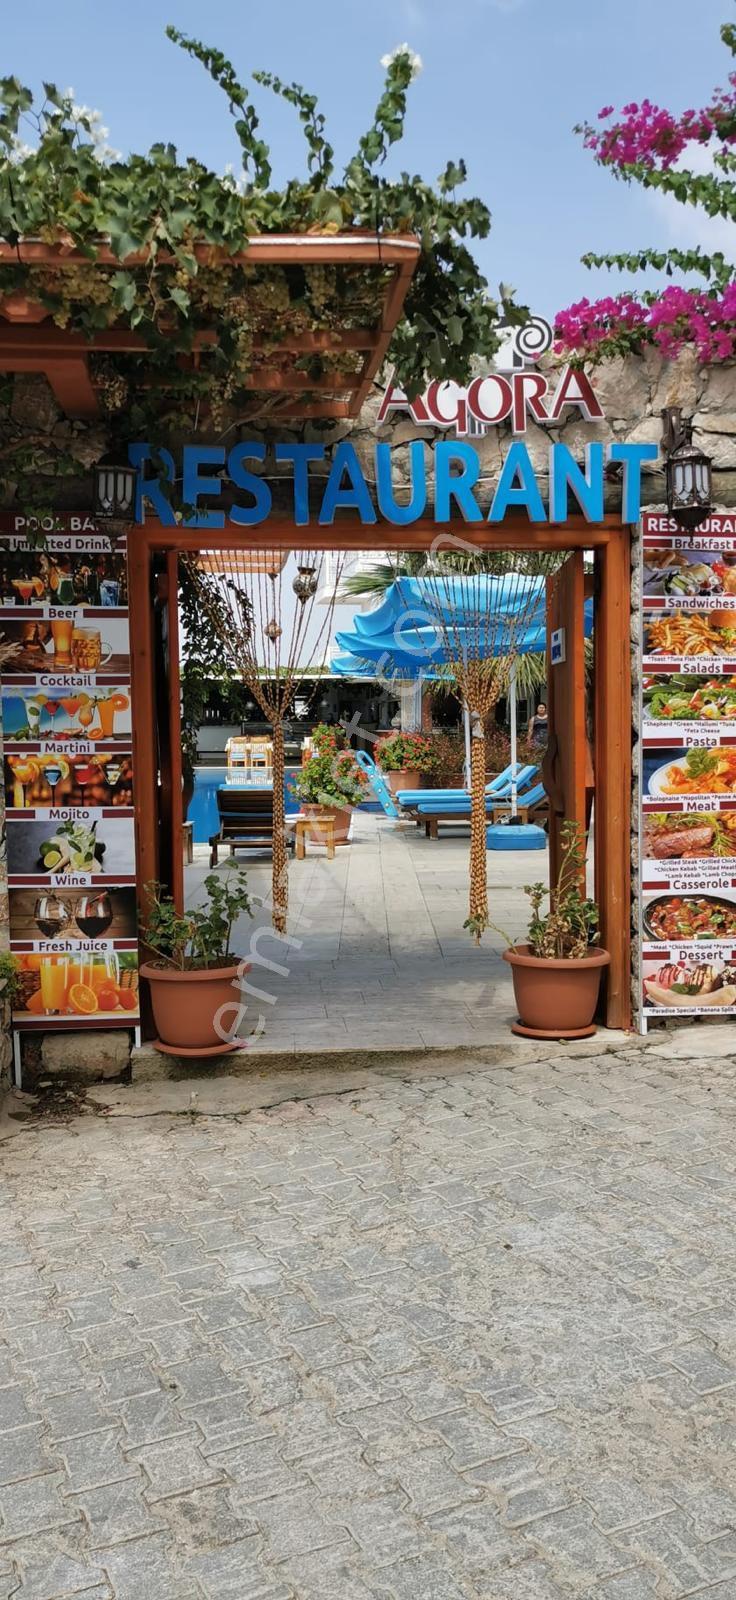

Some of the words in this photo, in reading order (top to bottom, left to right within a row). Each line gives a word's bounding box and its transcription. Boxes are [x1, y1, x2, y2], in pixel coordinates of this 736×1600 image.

[376, 366, 605, 437] AGORA
[128, 440, 659, 528] RESTAURANT
[70, 517, 99, 531] BA
[647, 517, 736, 533] RESURA
[674, 538, 731, 549] Breakfast
[667, 597, 735, 609] Sandwiches
[48, 608, 78, 619] Beer
[683, 663, 721, 674] Salads
[40, 675, 92, 687] Cocktail
[44, 742, 91, 753] Martini
[686, 736, 717, 747] Pasta
[686, 801, 716, 811] Meat
[49, 808, 90, 821] Mojito
[55, 875, 87, 885] Wine
[673, 877, 730, 890] Casserole
[38, 941, 72, 952] Fresh
[75, 940, 108, 951] Juice
[679, 950, 724, 960] Dessert
